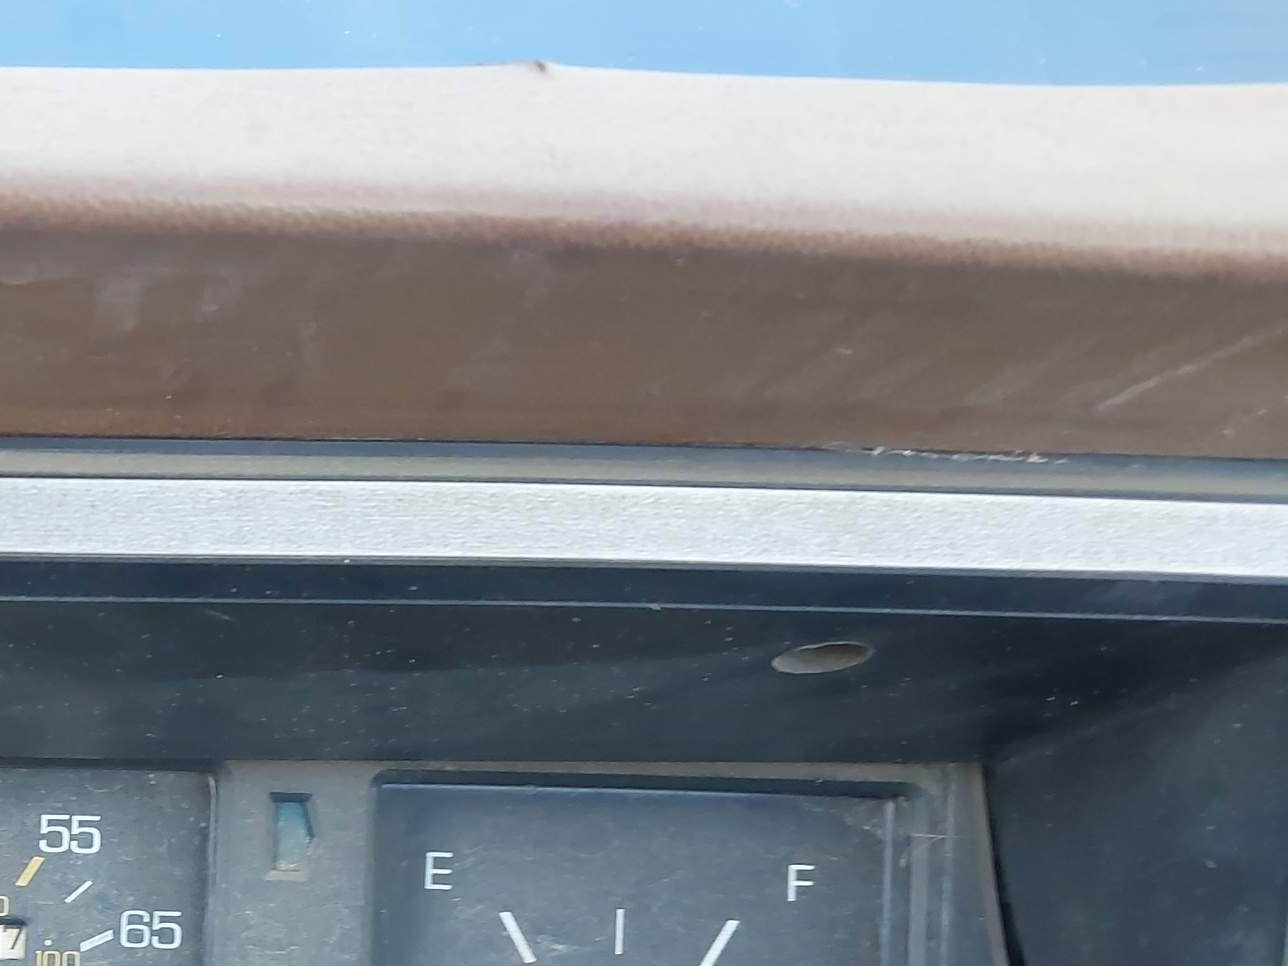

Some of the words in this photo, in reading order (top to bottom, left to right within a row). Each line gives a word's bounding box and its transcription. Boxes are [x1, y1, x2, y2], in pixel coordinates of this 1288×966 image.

[38, 814, 102, 855] 55
[423, 851, 454, 891] E
[787, 864, 815, 902] F
[119, 911, 183, 950] 65
